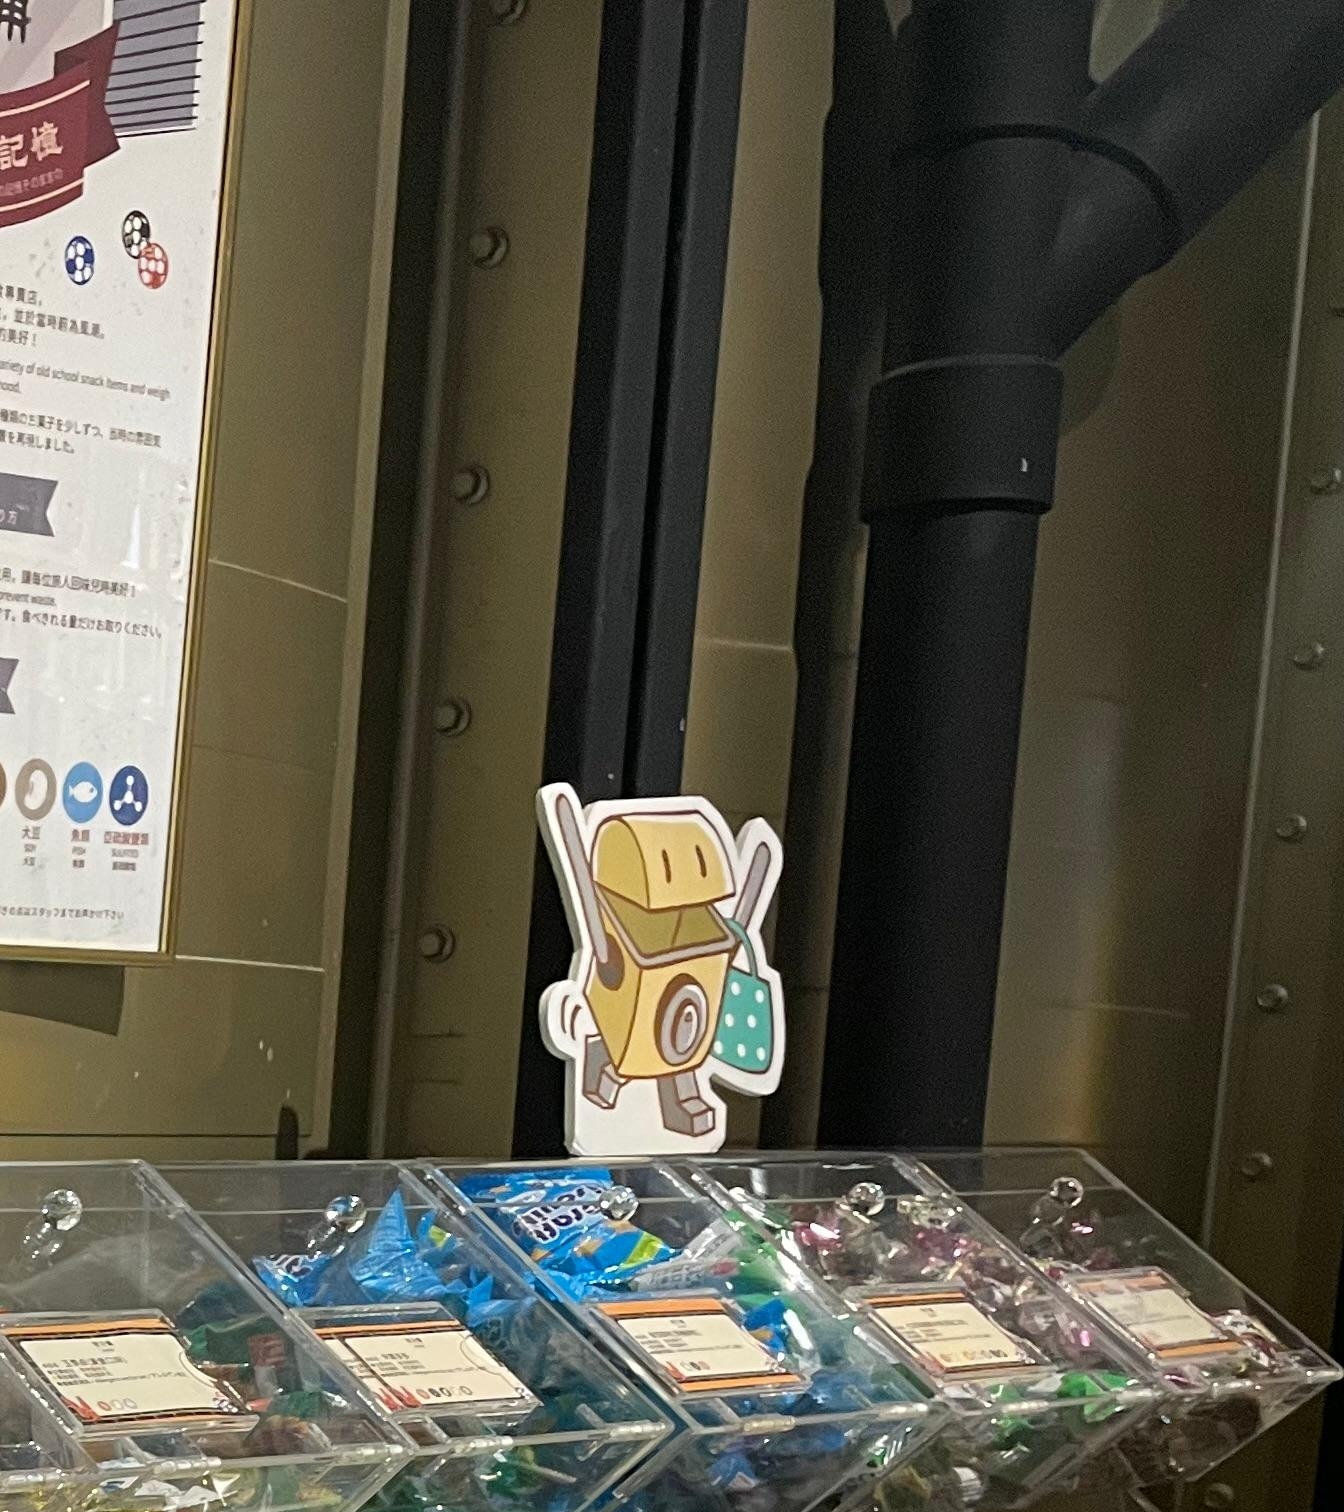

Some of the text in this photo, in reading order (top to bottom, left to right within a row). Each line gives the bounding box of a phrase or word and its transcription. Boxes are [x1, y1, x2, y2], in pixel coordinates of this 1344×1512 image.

[36, 363, 50, 377] old
[52, 366, 78, 383] school
[80, 371, 104, 387] snack
[129, 381, 145, 395] and
[22, 826, 41, 839] 大豆
